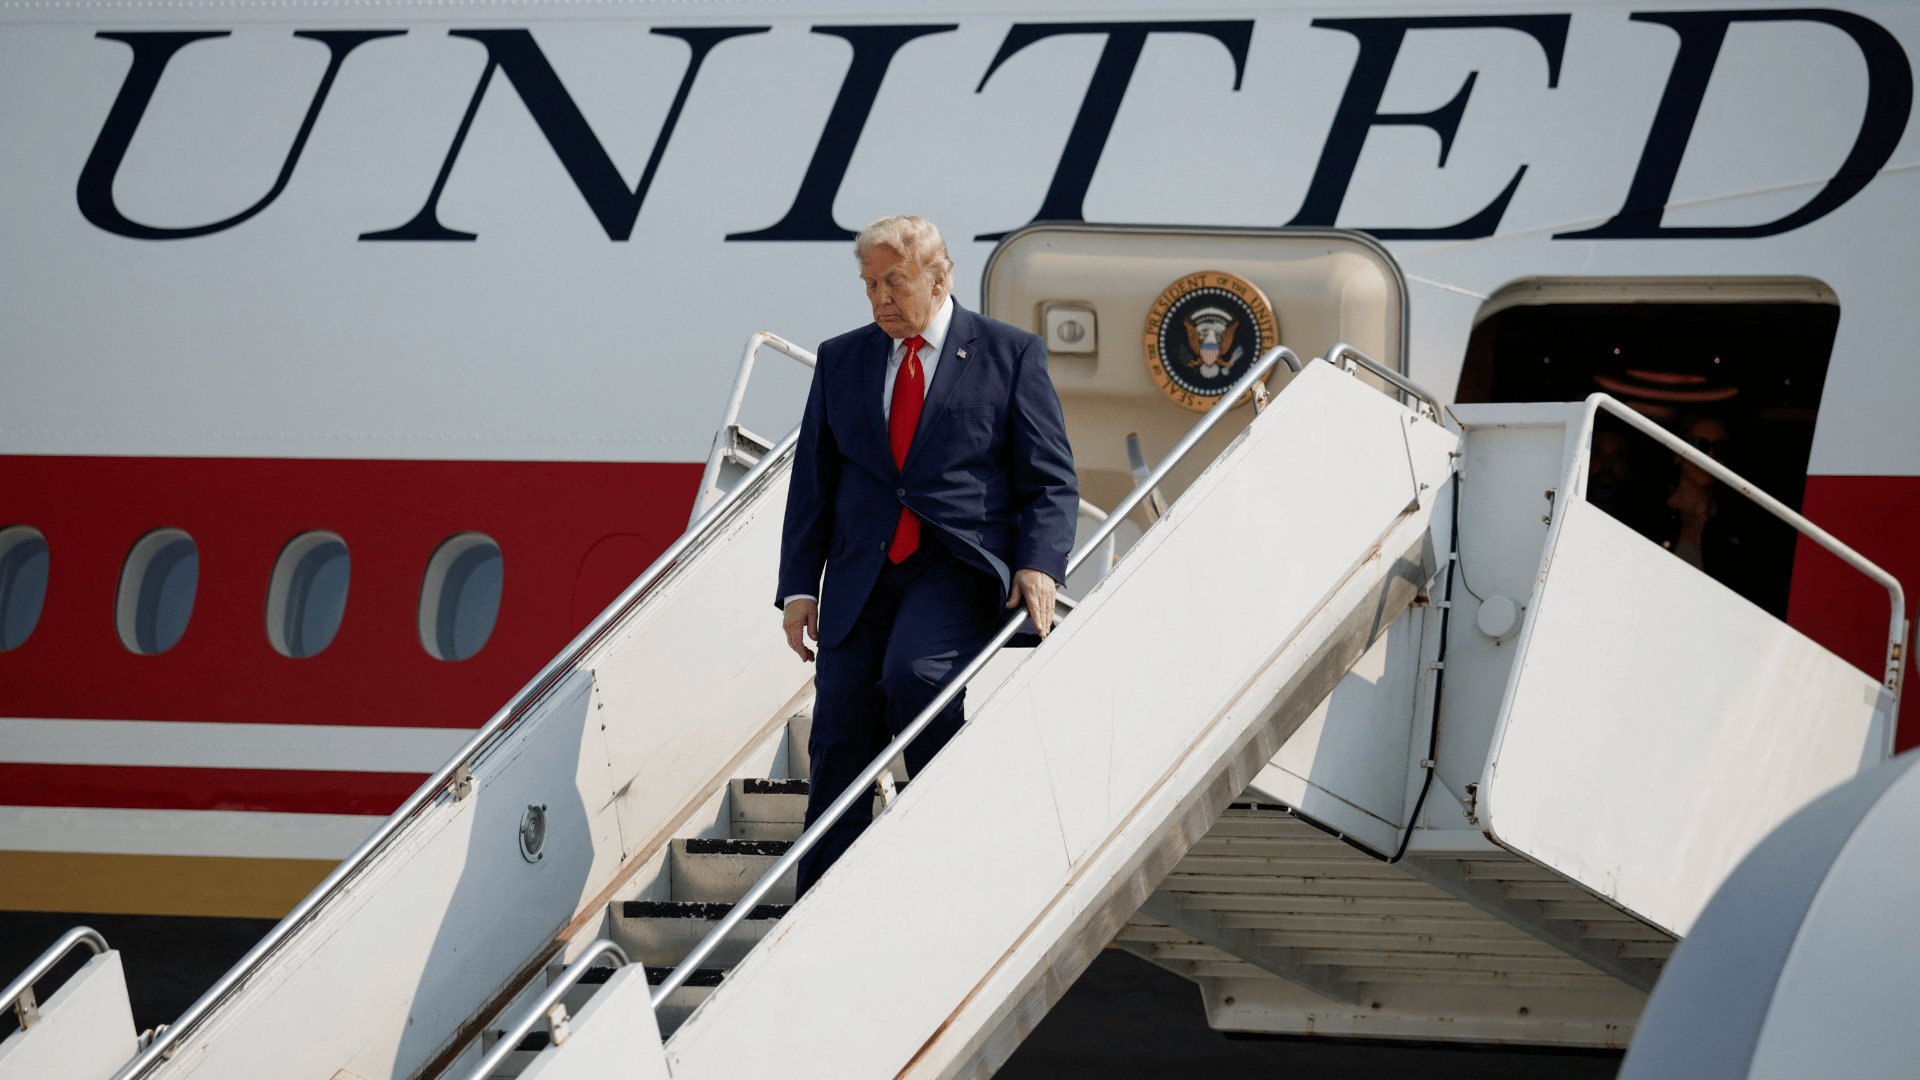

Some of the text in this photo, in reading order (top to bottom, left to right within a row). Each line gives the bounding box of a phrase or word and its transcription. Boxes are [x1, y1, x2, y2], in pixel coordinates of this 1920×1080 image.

[77, 9, 1912, 240] UNITED
[1217, 277, 1229, 285] OF
[1232, 281, 1247, 295] THE
[1146, 275, 1207, 335] PRESIDENT
[1147, 344, 1156, 360] THE
[1153, 365, 1161, 375] OF
[1162, 380, 1195, 406] SEAL
